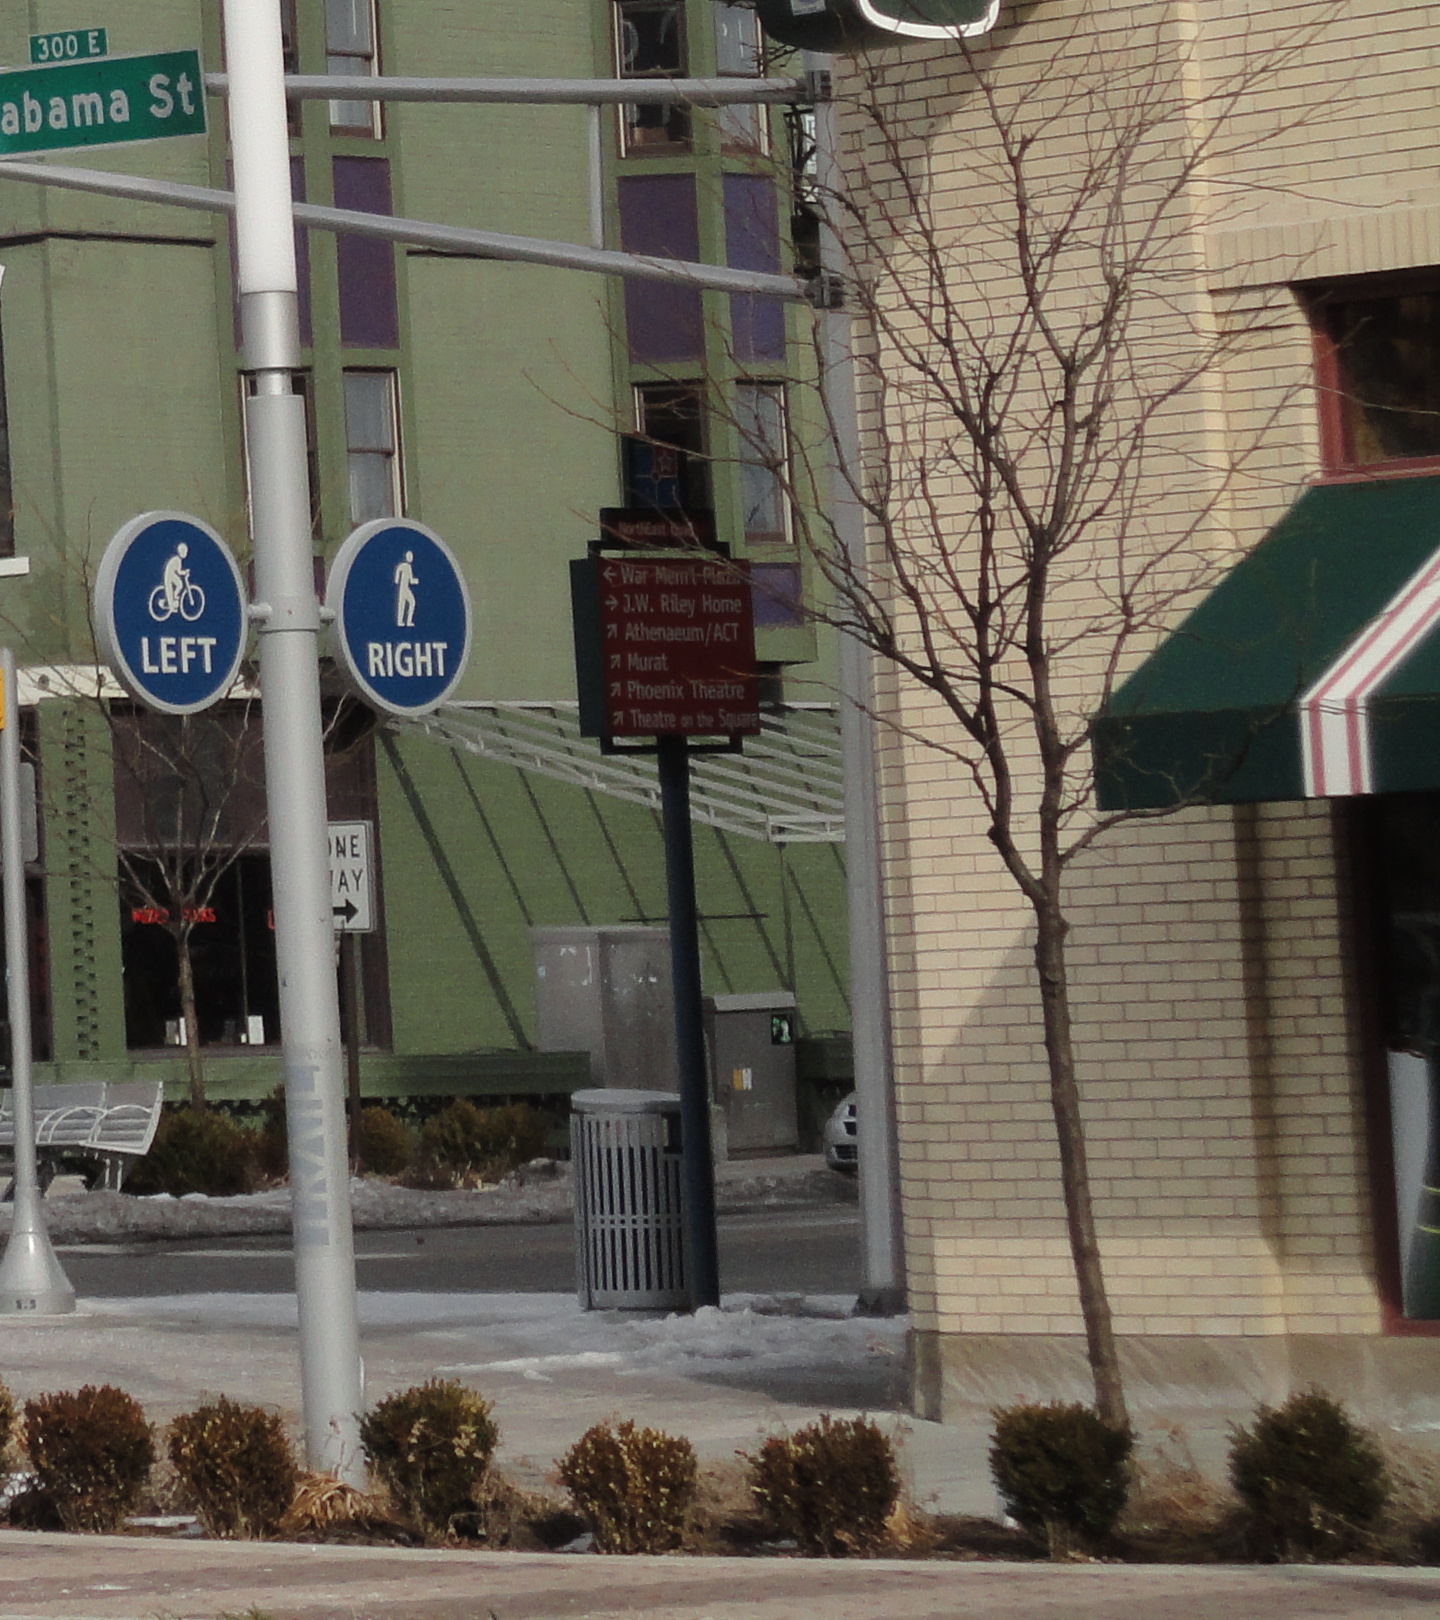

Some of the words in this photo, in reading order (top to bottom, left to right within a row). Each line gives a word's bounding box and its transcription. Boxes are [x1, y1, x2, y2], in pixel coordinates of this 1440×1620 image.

[37, 34, 78, 61] 300
[88, 31, 101, 54] E
[148, 71, 196, 119] St
[620, 566, 648, 585] War
[623, 594, 655, 614] J.W.
[661, 594, 695, 619] Riley
[702, 594, 742, 614] Home
[141, 637, 217, 675] LEFT
[367, 642, 448, 678] RIGHT
[628, 651, 669, 671] Murat
[627, 680, 685, 700] Phoenix
[690, 679, 745, 700] Theatre
[630, 708, 676, 729] Theatre
[697, 710, 714, 728] the
[720, 707, 758, 731] Square
[328, 833, 361, 859] NE
[329, 868, 364, 893] AY
